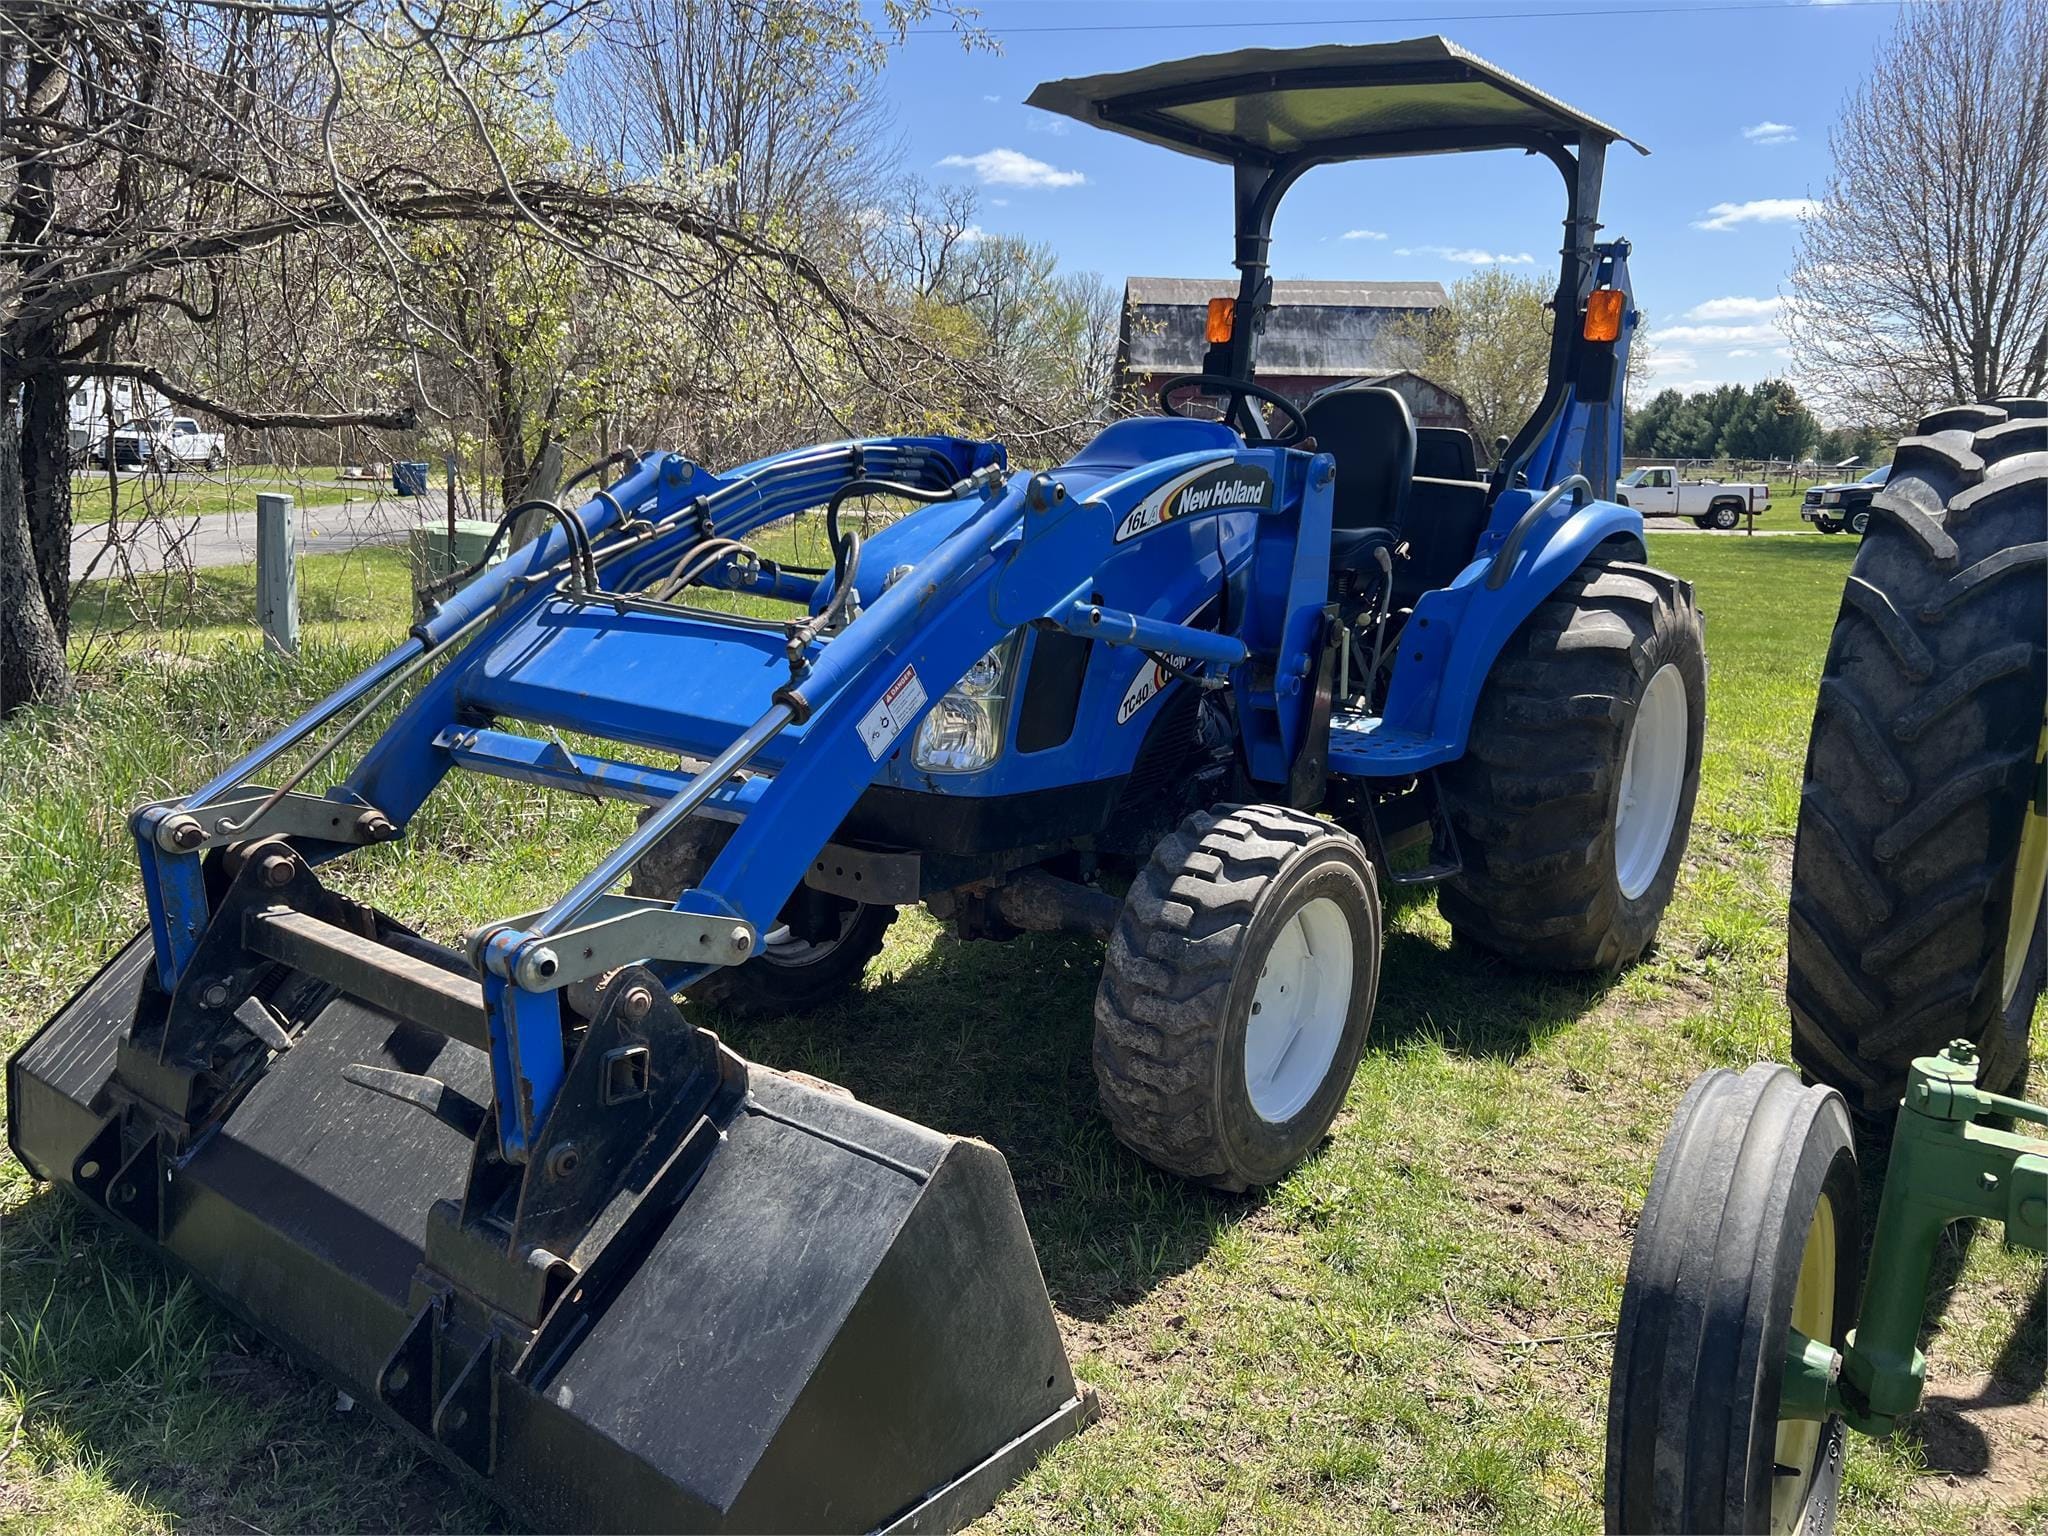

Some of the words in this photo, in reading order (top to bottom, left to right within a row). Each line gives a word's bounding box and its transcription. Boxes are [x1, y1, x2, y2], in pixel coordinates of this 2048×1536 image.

[1178, 486, 1214, 515] New
[1215, 480, 1265, 505] Holland
[890, 669, 912, 695] DANGER
